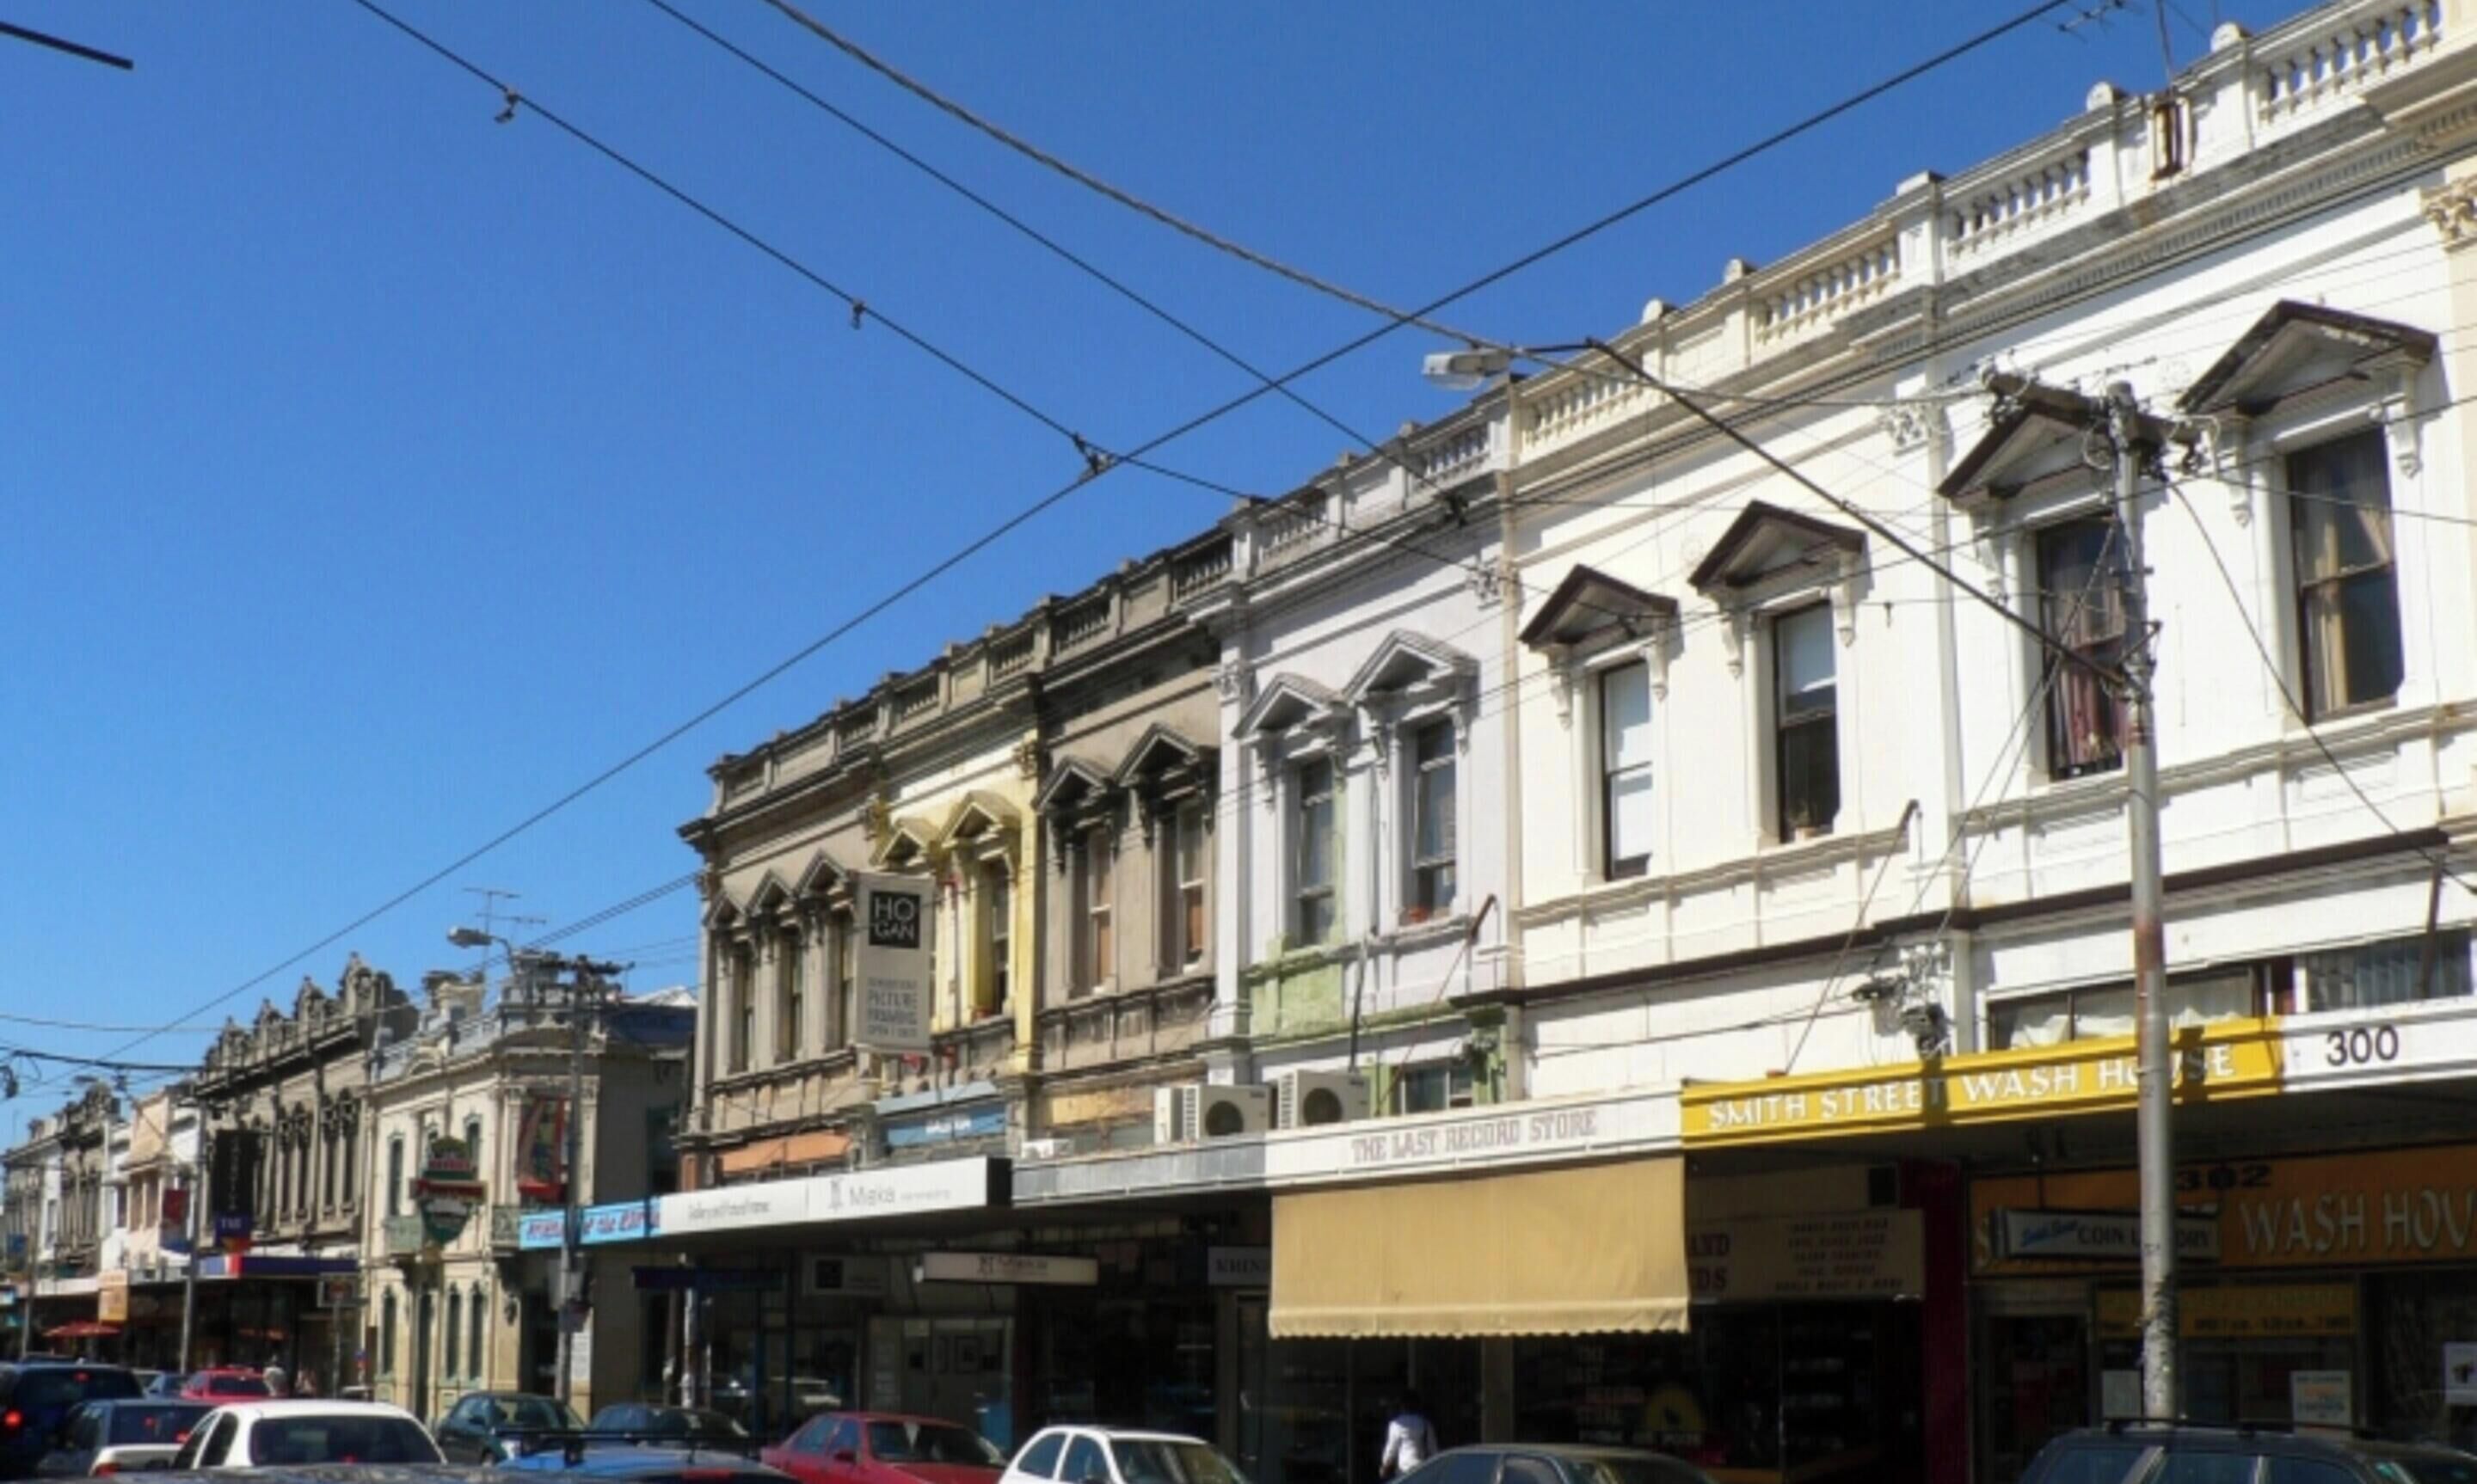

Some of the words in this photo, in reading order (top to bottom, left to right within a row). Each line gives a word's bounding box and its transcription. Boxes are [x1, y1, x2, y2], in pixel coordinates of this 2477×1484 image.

[2326, 1025, 2399, 1066] 300
[1709, 1094, 1806, 1131] SMITH
[1821, 1078, 1942, 1121] STREET
[1961, 1064, 2078, 1102] WASH
[2098, 1044, 2234, 1090] HSE
[1351, 1136, 1386, 1164] THE
[1392, 1130, 1438, 1159] LAST
[1445, 1119, 1521, 1153] RECORD
[1528, 1110, 1597, 1142] STORE
[2177, 1164, 2271, 1191] 302
[2077, 1225, 2124, 1246] COIN
[2130, 1227, 2209, 1249] LDRY
[2239, 1193, 2366, 1254] WASH
